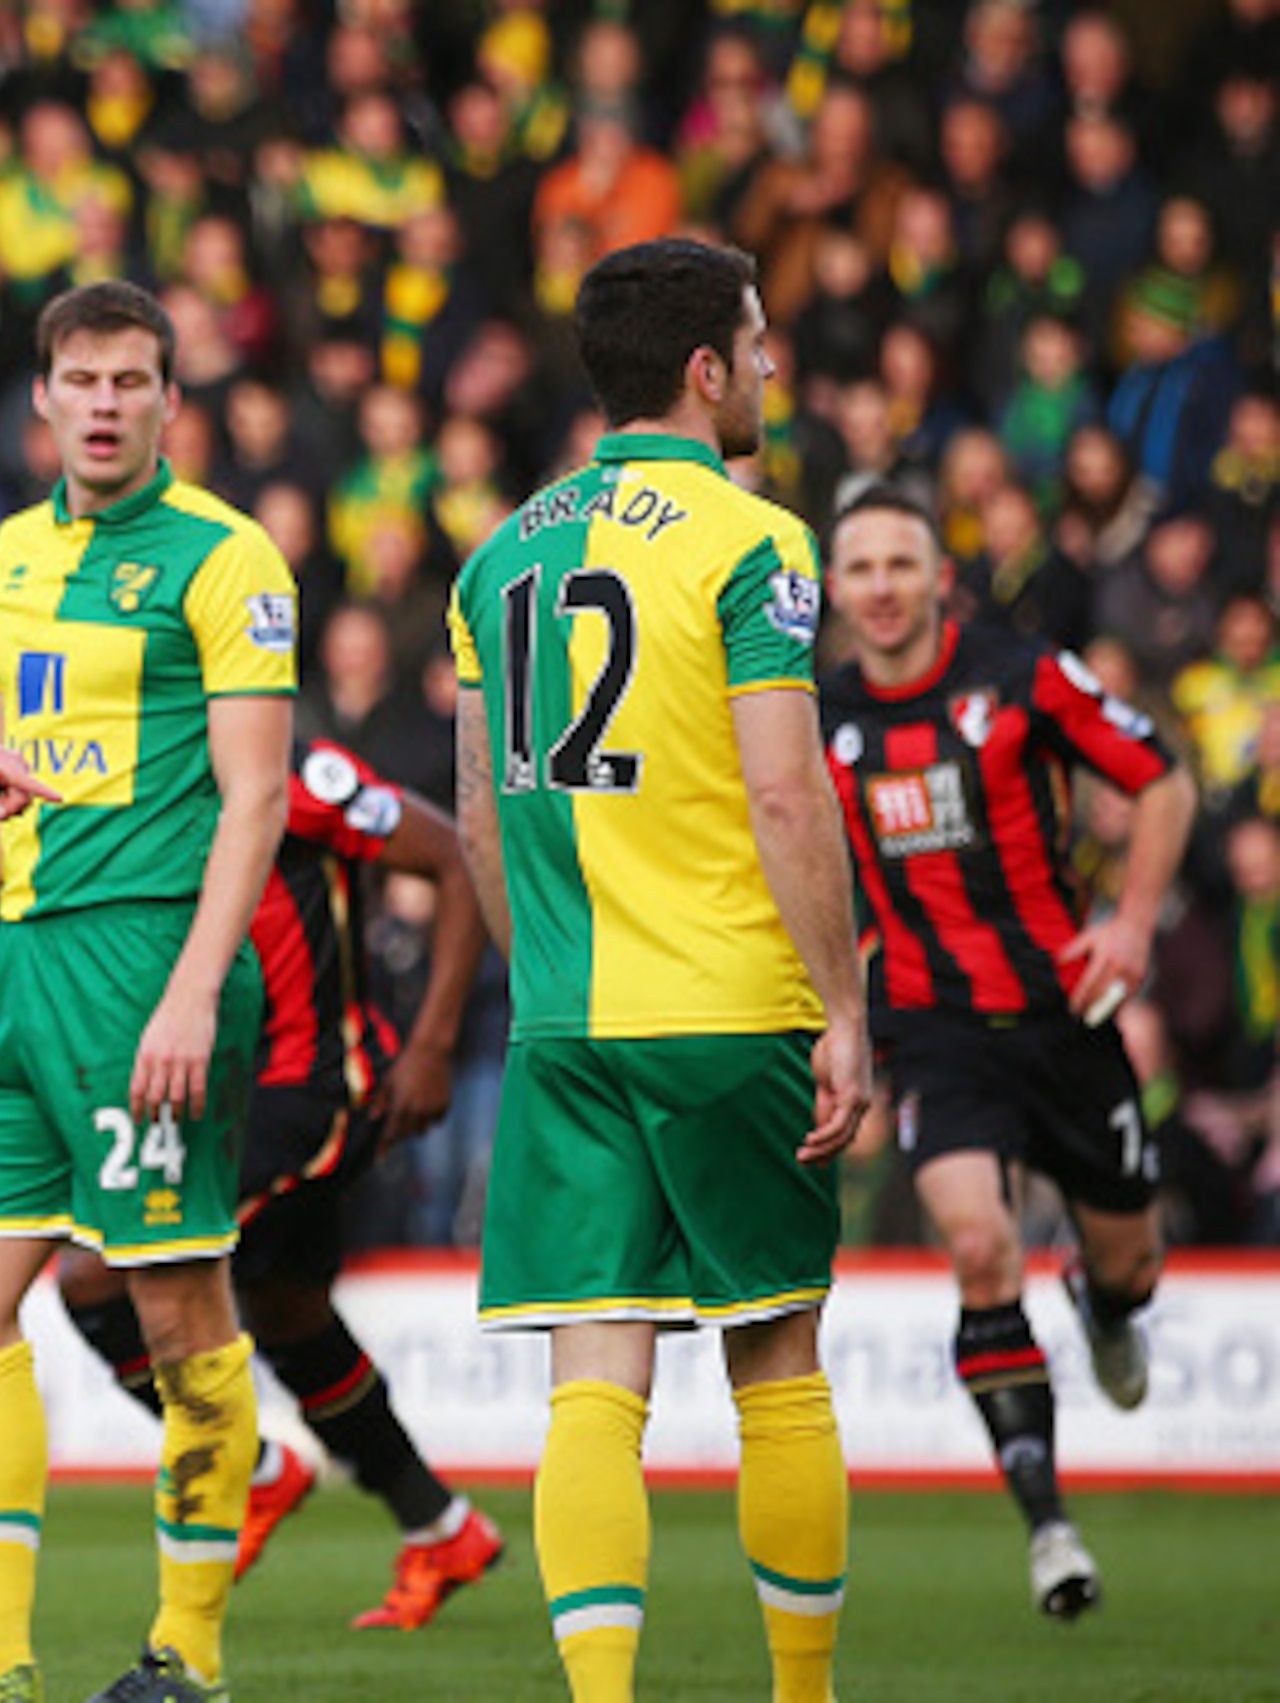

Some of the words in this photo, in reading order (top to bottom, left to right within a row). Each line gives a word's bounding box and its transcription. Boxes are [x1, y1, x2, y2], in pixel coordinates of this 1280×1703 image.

[519, 485, 688, 542] BRADY
[499, 563, 644, 795] 12
[94, 1100, 187, 1190] 24
